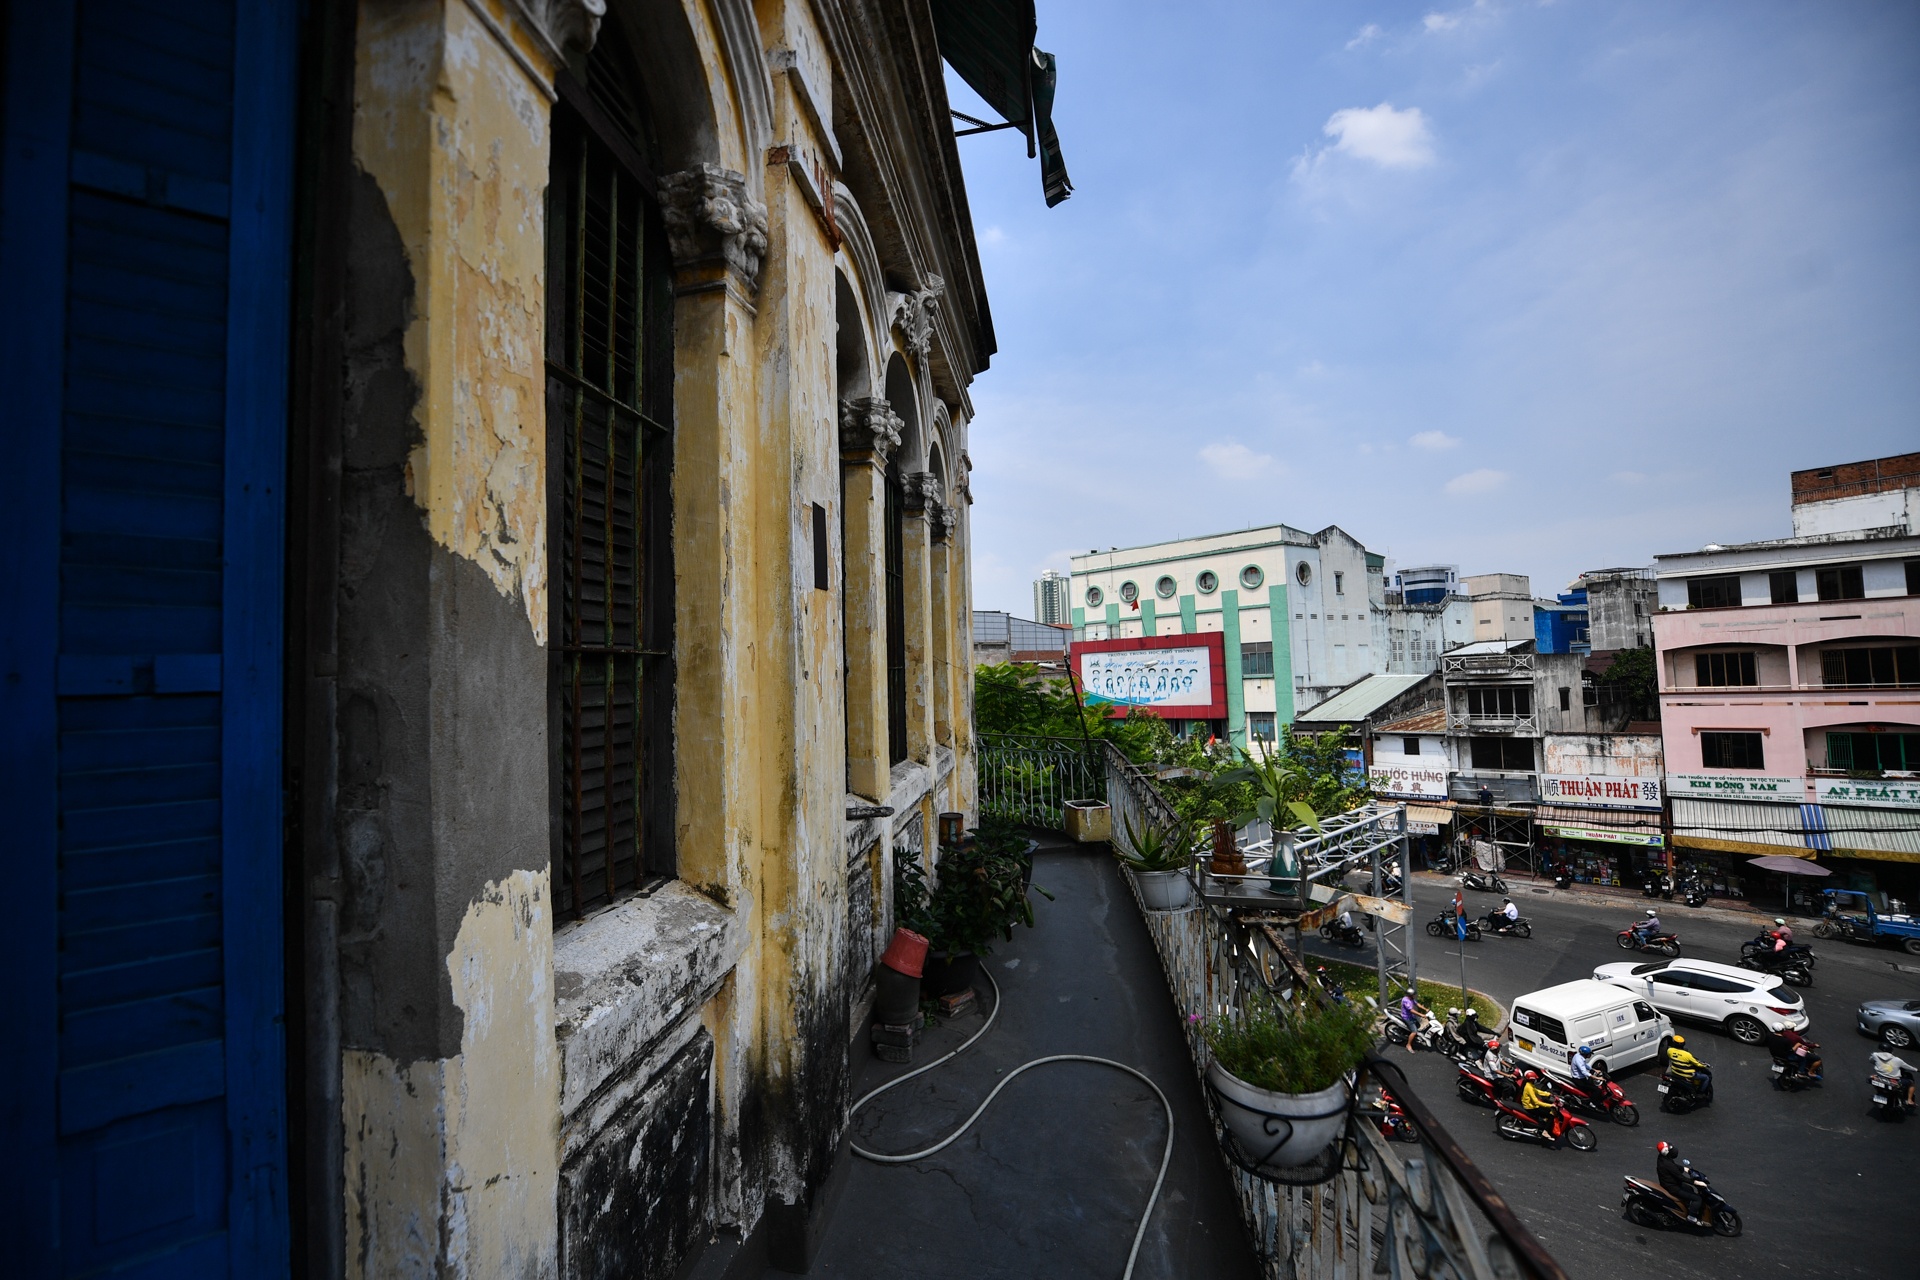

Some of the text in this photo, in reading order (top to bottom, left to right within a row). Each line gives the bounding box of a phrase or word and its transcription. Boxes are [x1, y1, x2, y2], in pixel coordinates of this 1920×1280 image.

[1412, 770, 1443, 783] HƯNG
[1560, 777, 1639, 800] THUẬN PHÁT
[1641, 781, 1659, 801] 發
[1690, 780, 1778, 791] KIM ĐÔNG NAM
[1828, 786, 1850, 796] AN
[1856, 786, 1901, 798] PHÁT
